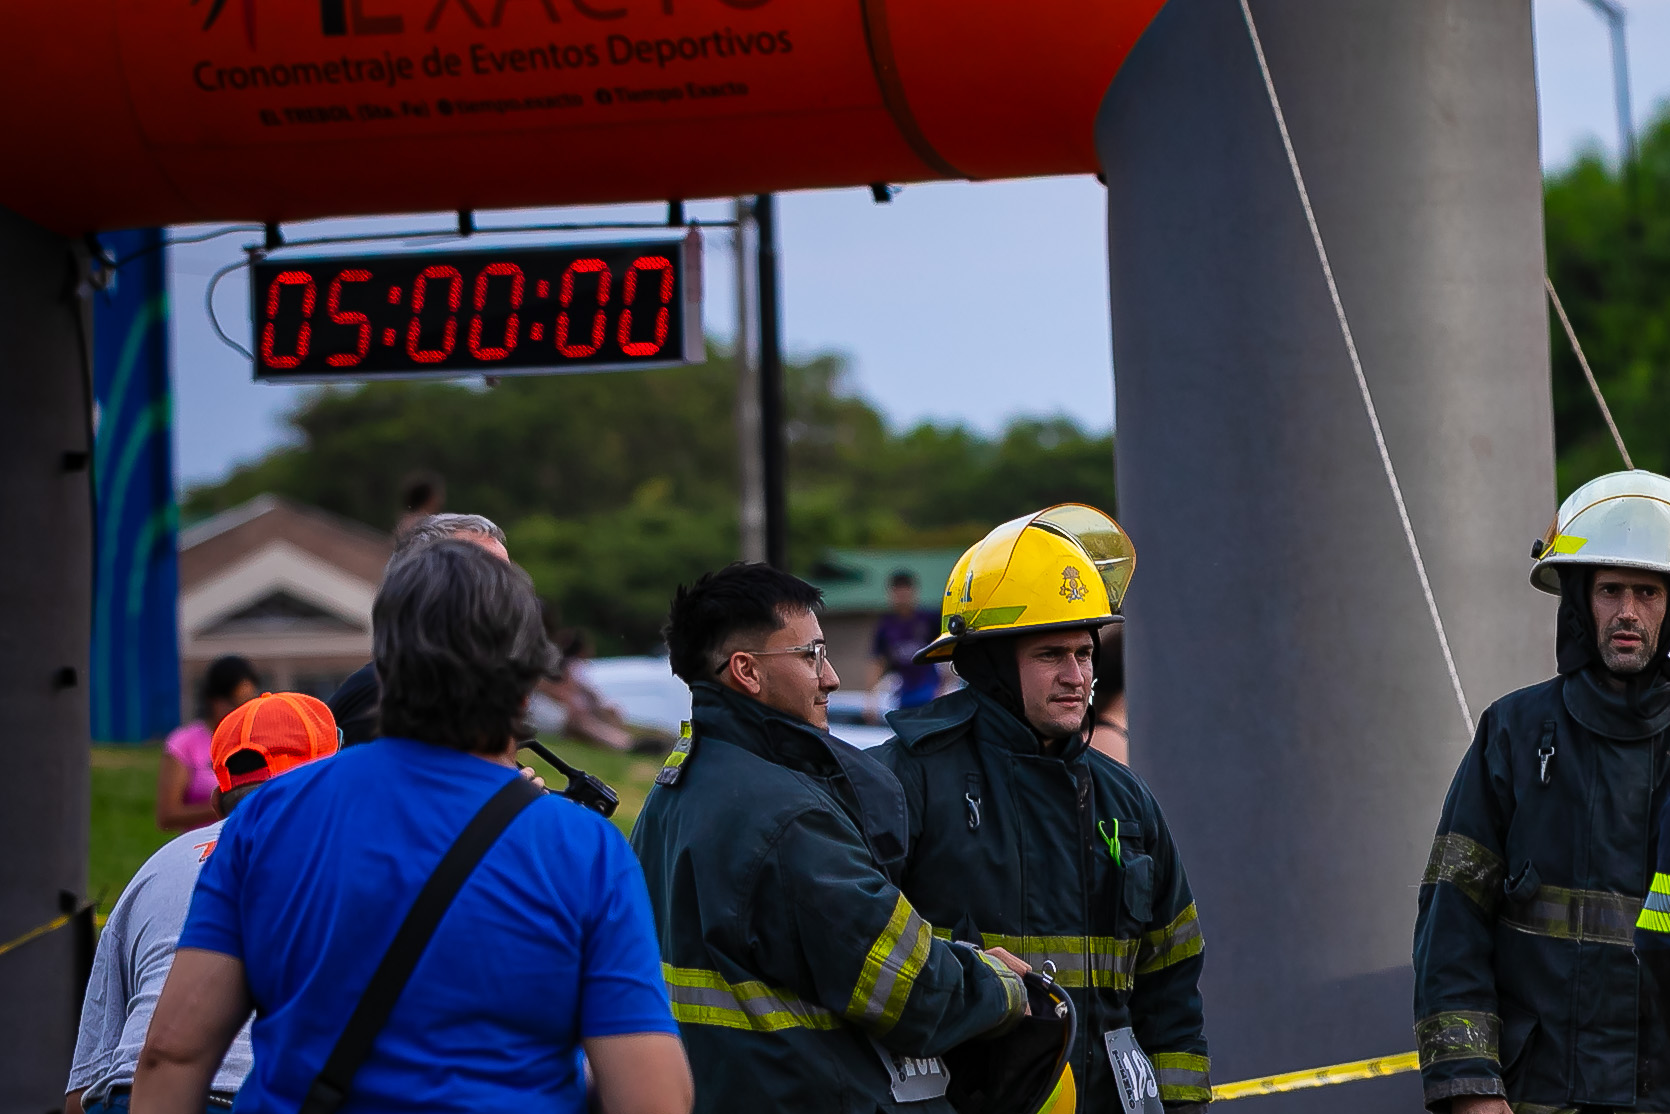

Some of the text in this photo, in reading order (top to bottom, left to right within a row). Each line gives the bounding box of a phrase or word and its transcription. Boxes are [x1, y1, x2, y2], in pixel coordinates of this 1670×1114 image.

[192, 26, 793, 92] Cronometraje de Eventos Deportivos
[261, 255, 675, 369] 05:00:00
[1111, 1049, 1136, 1110] TIEMPO
